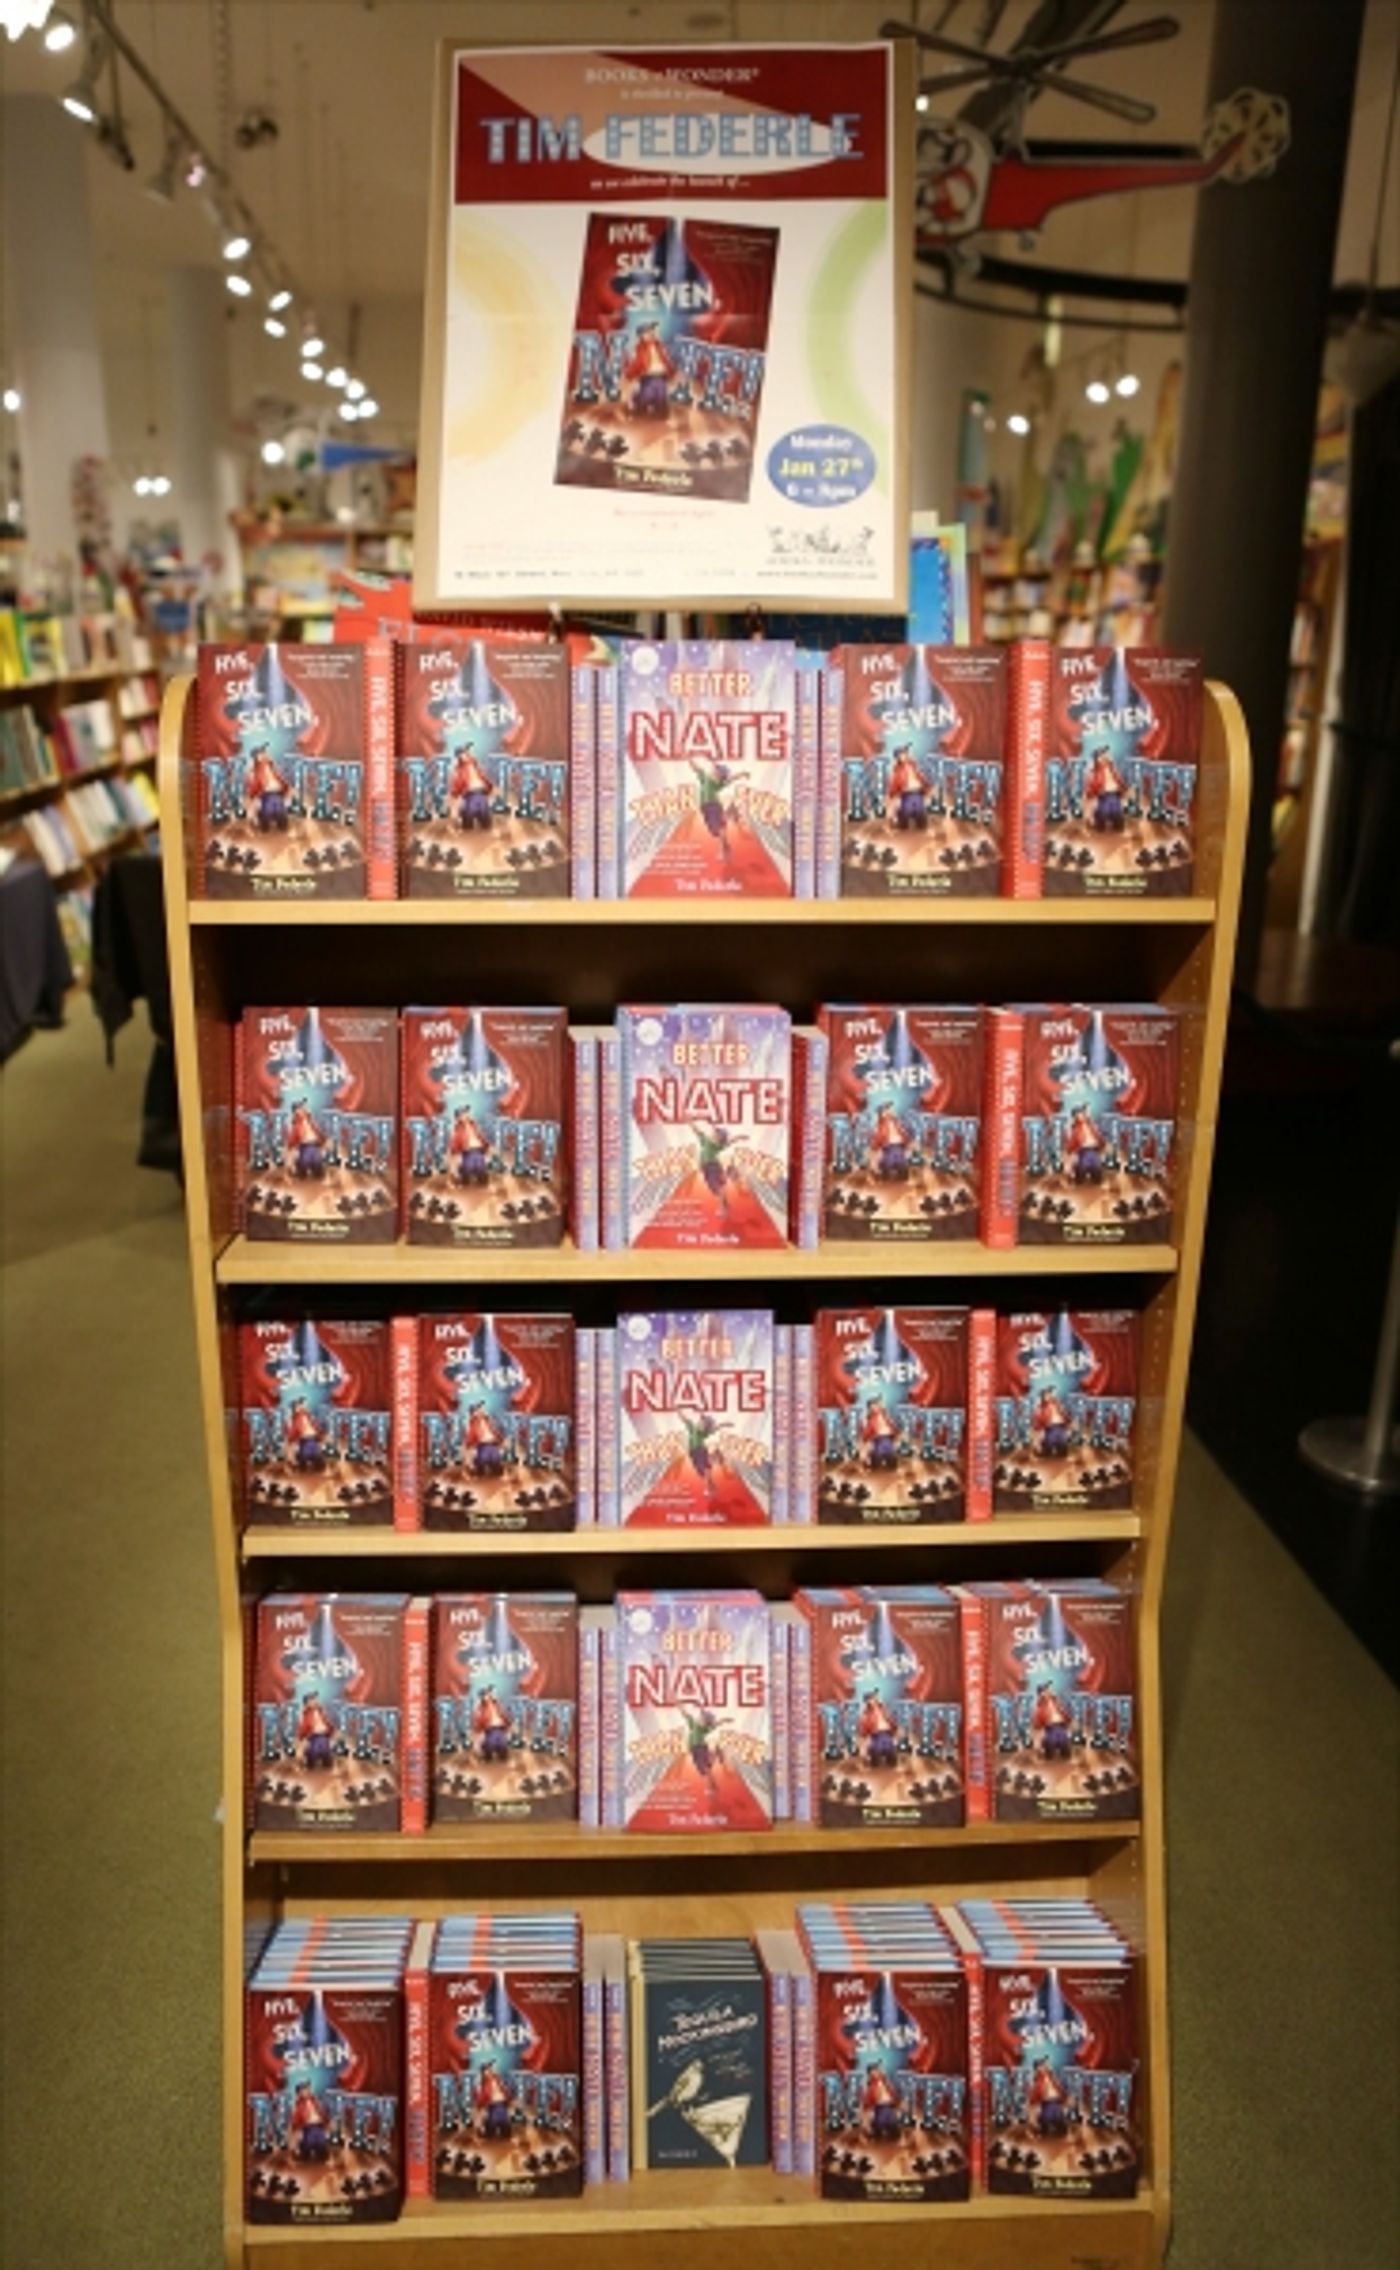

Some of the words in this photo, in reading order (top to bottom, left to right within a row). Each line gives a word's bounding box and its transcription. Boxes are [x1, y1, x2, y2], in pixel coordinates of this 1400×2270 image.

[480, 115, 582, 163] TIM
[605, 112, 864, 160] FEDERLE
[790, 434, 852, 451] Monday
[778, 458, 815, 477] Jan
[670, 672, 751, 698] BETTER
[629, 710, 788, 761] NATE
[674, 1043, 749, 1065] BETTER
[633, 1078, 784, 1125] NATE
[627, 1370, 765, 1412] NATE
[628, 1664, 766, 1708] NATE
